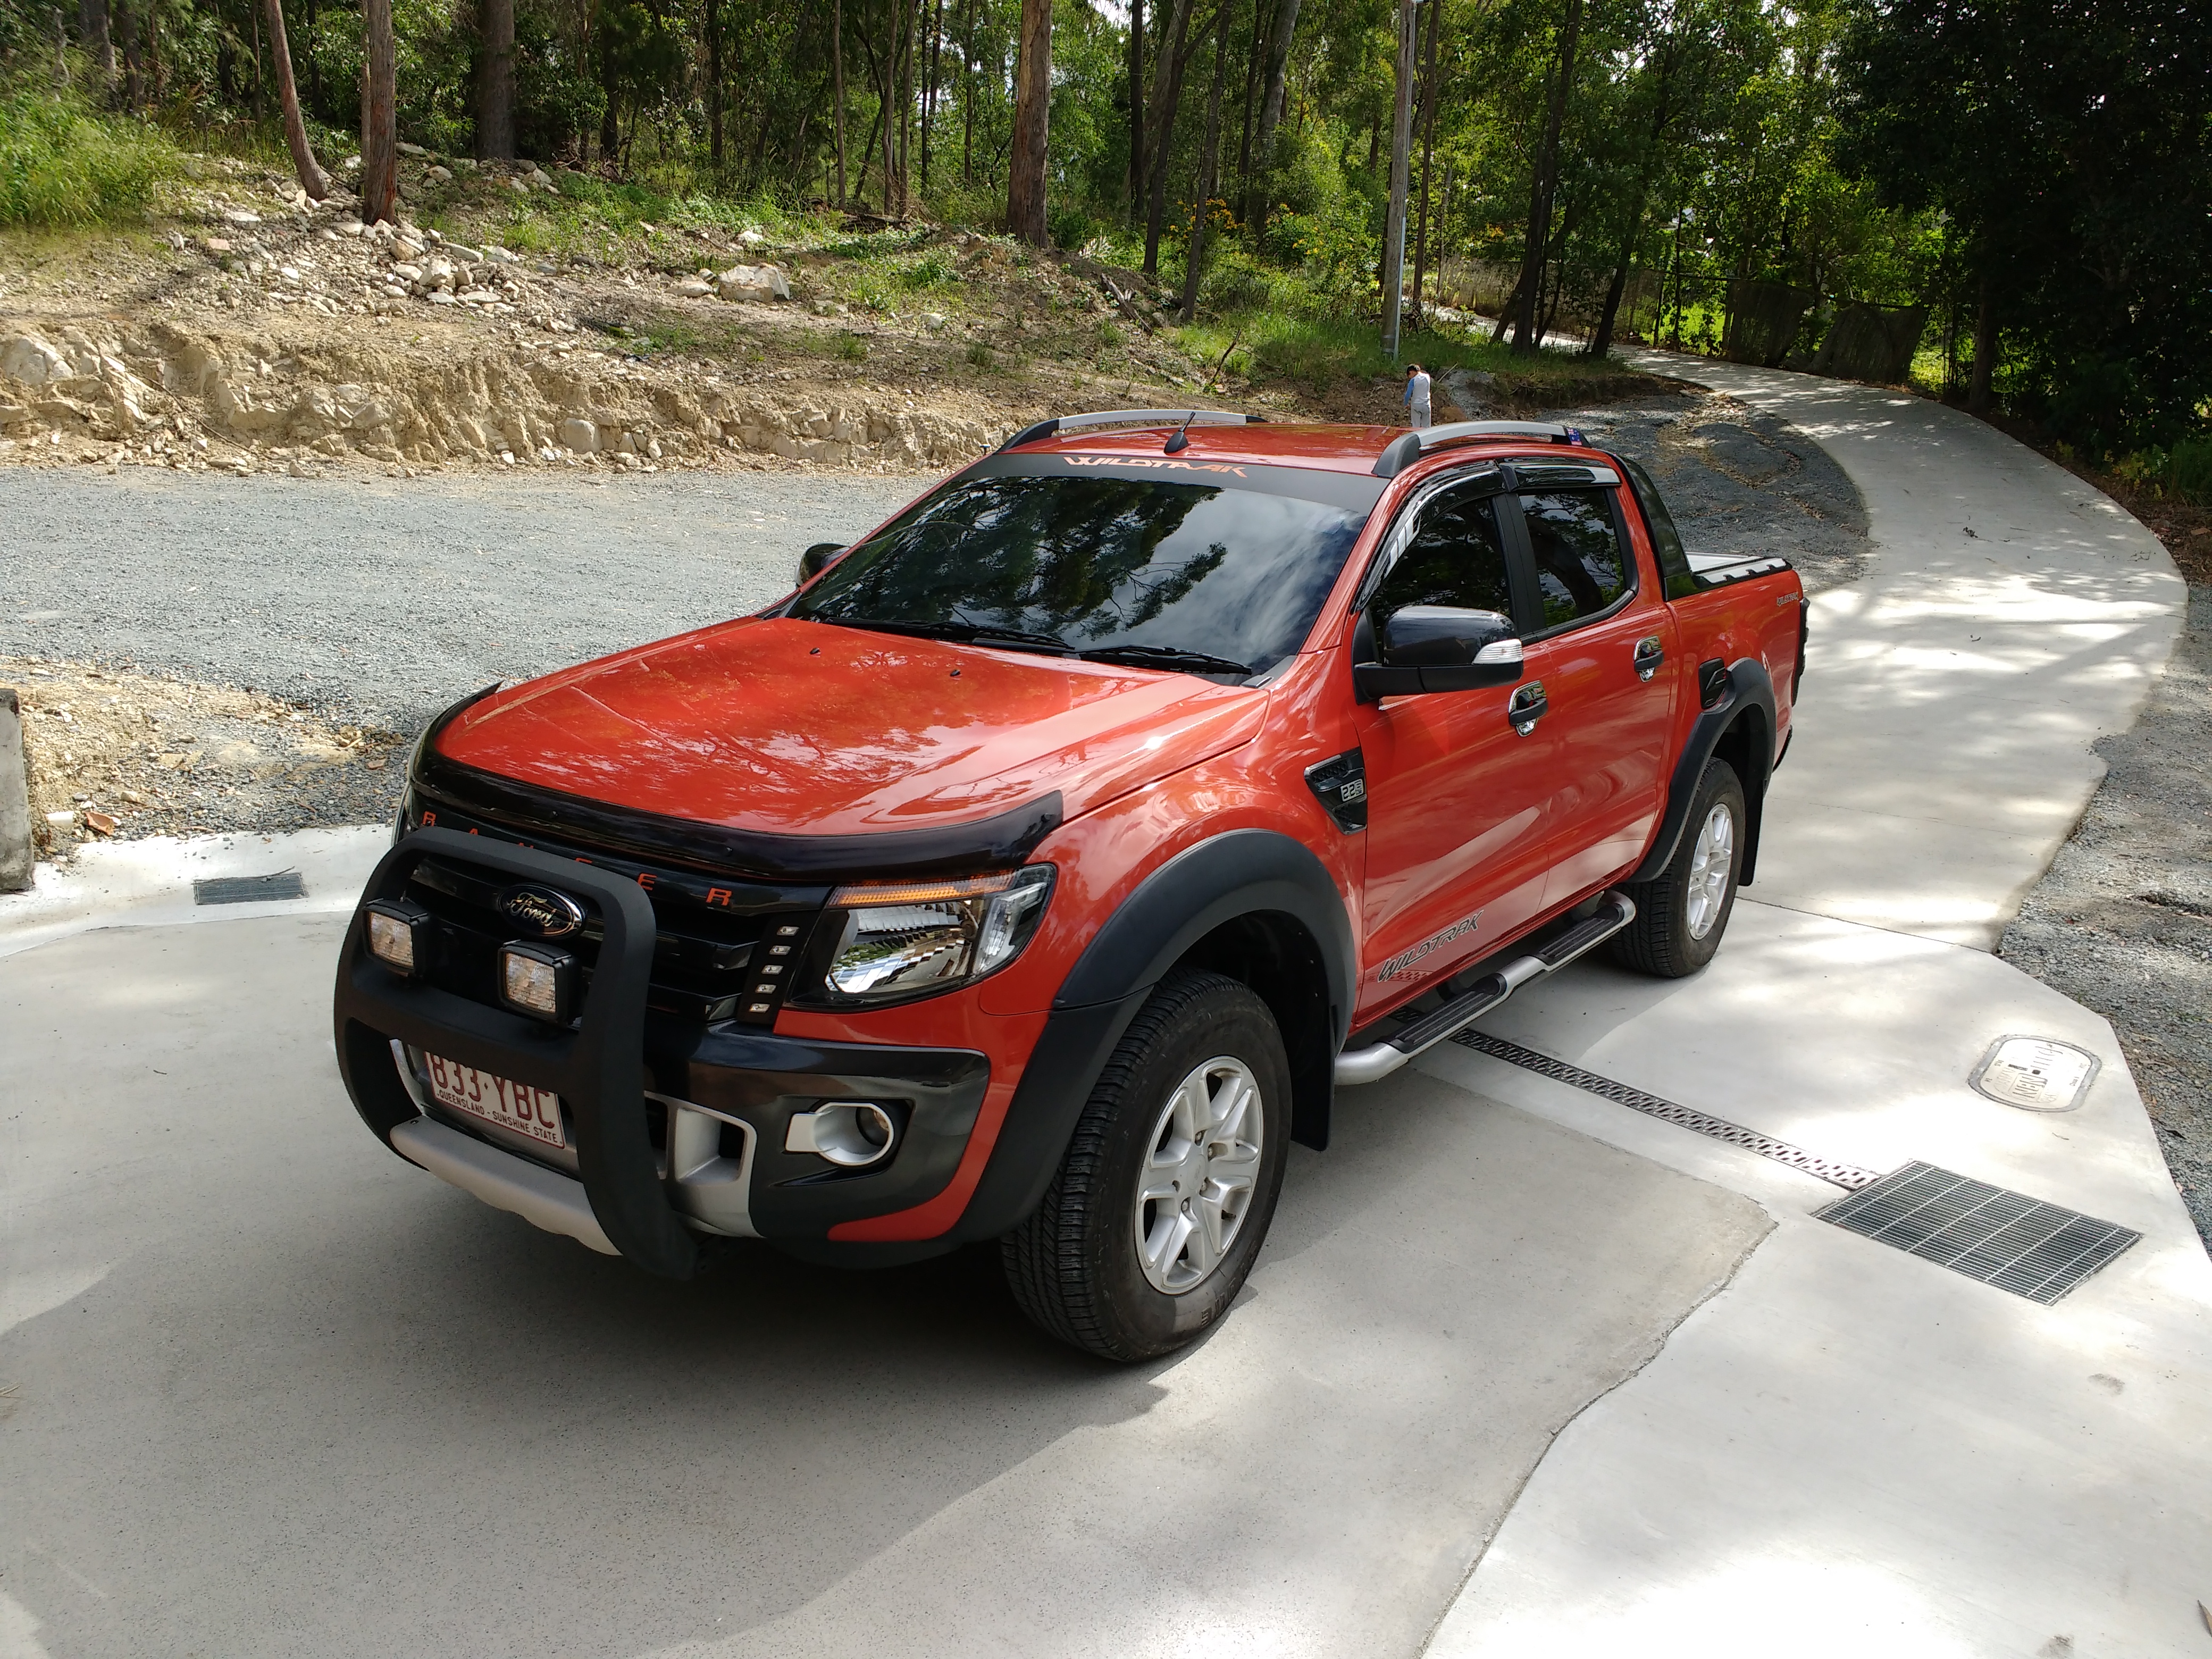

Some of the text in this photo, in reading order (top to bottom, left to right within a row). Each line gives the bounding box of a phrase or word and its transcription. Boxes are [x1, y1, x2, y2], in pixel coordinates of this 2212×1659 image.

[506, 892, 556, 927] Ford
[1377, 909, 1485, 983] WILDTRAK
[439, 1089, 558, 1143] QUEENSLAND SUNSHINE STATE
